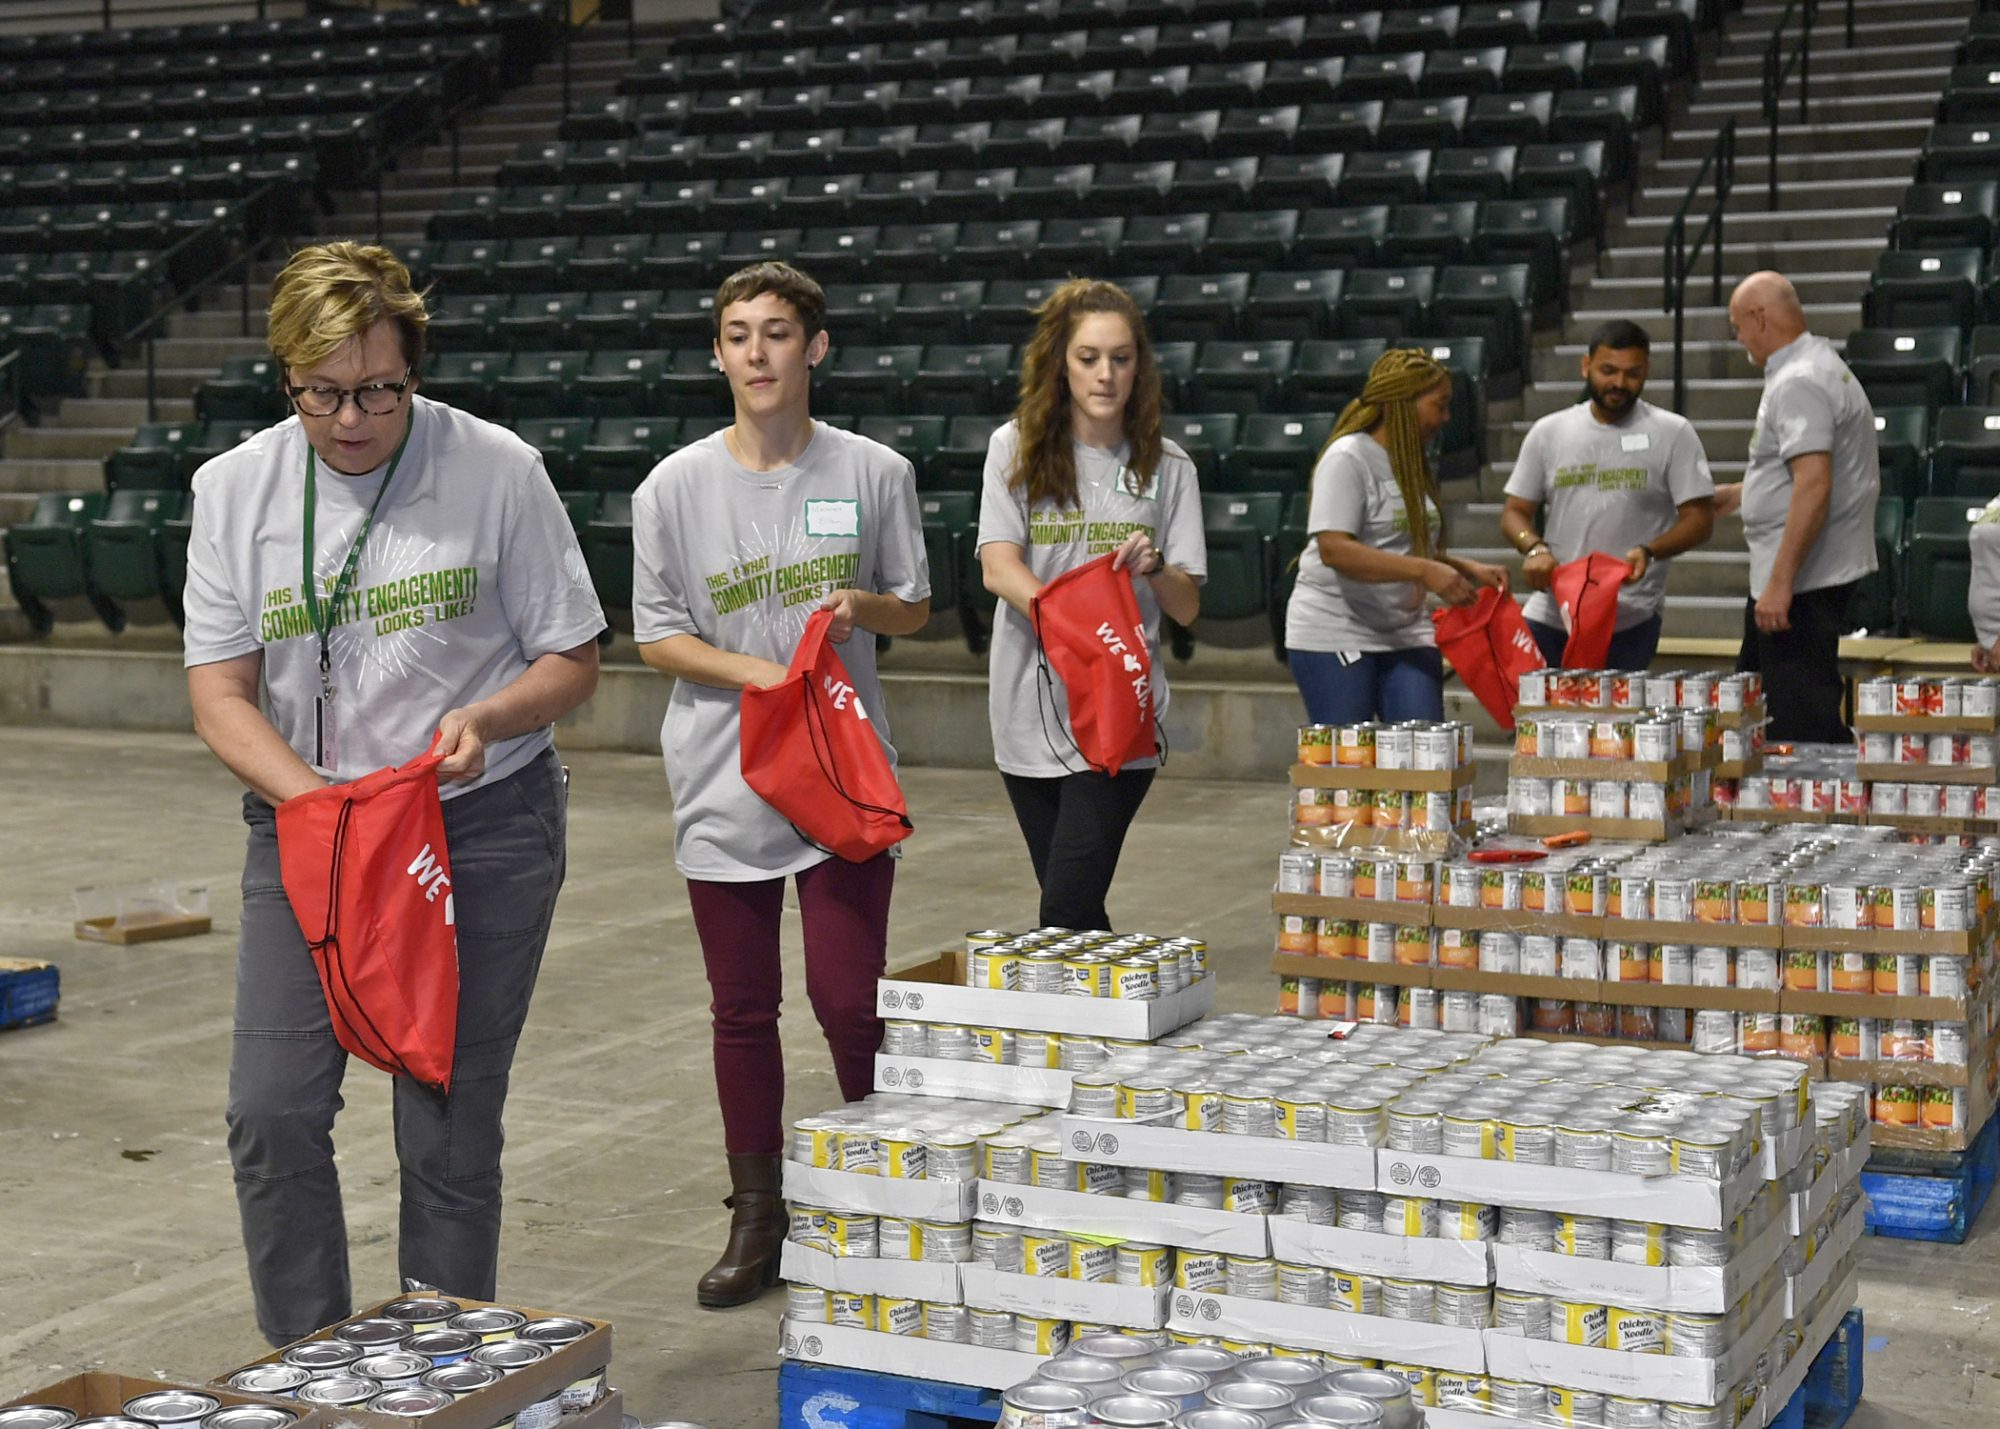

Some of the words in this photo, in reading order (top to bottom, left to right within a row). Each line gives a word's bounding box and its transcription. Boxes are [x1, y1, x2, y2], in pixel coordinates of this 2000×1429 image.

[1030, 523, 1085, 545] OMMUNITY
[705, 571, 729, 590] THIS
[741, 555, 769, 577] WHAT
[776, 553, 861, 594] ENGAGEMENT!
[367, 566, 478, 618] ENGAGEMENT!
[783, 585, 822, 608] LOOKS
[376, 609, 425, 637] LOOKS
[1096, 621, 1127, 656] WE
[407, 843, 450, 902] WE
[1120, 972, 1148, 985] Chicken
[1125, 980, 1149, 991] Noodle
[842, 1140, 867, 1150] Chicken
[846, 1147, 869, 1157] Noodle
[1090, 1172, 1116, 1183] Noodle
[1232, 1183, 1262, 1195] Chicken
[1184, 1259, 1213, 1271] Chicken
[1189, 1267, 1215, 1280] Noodle
[1619, 1319, 1651, 1331] Chicken
[1624, 1327, 1654, 1340] Noodle
